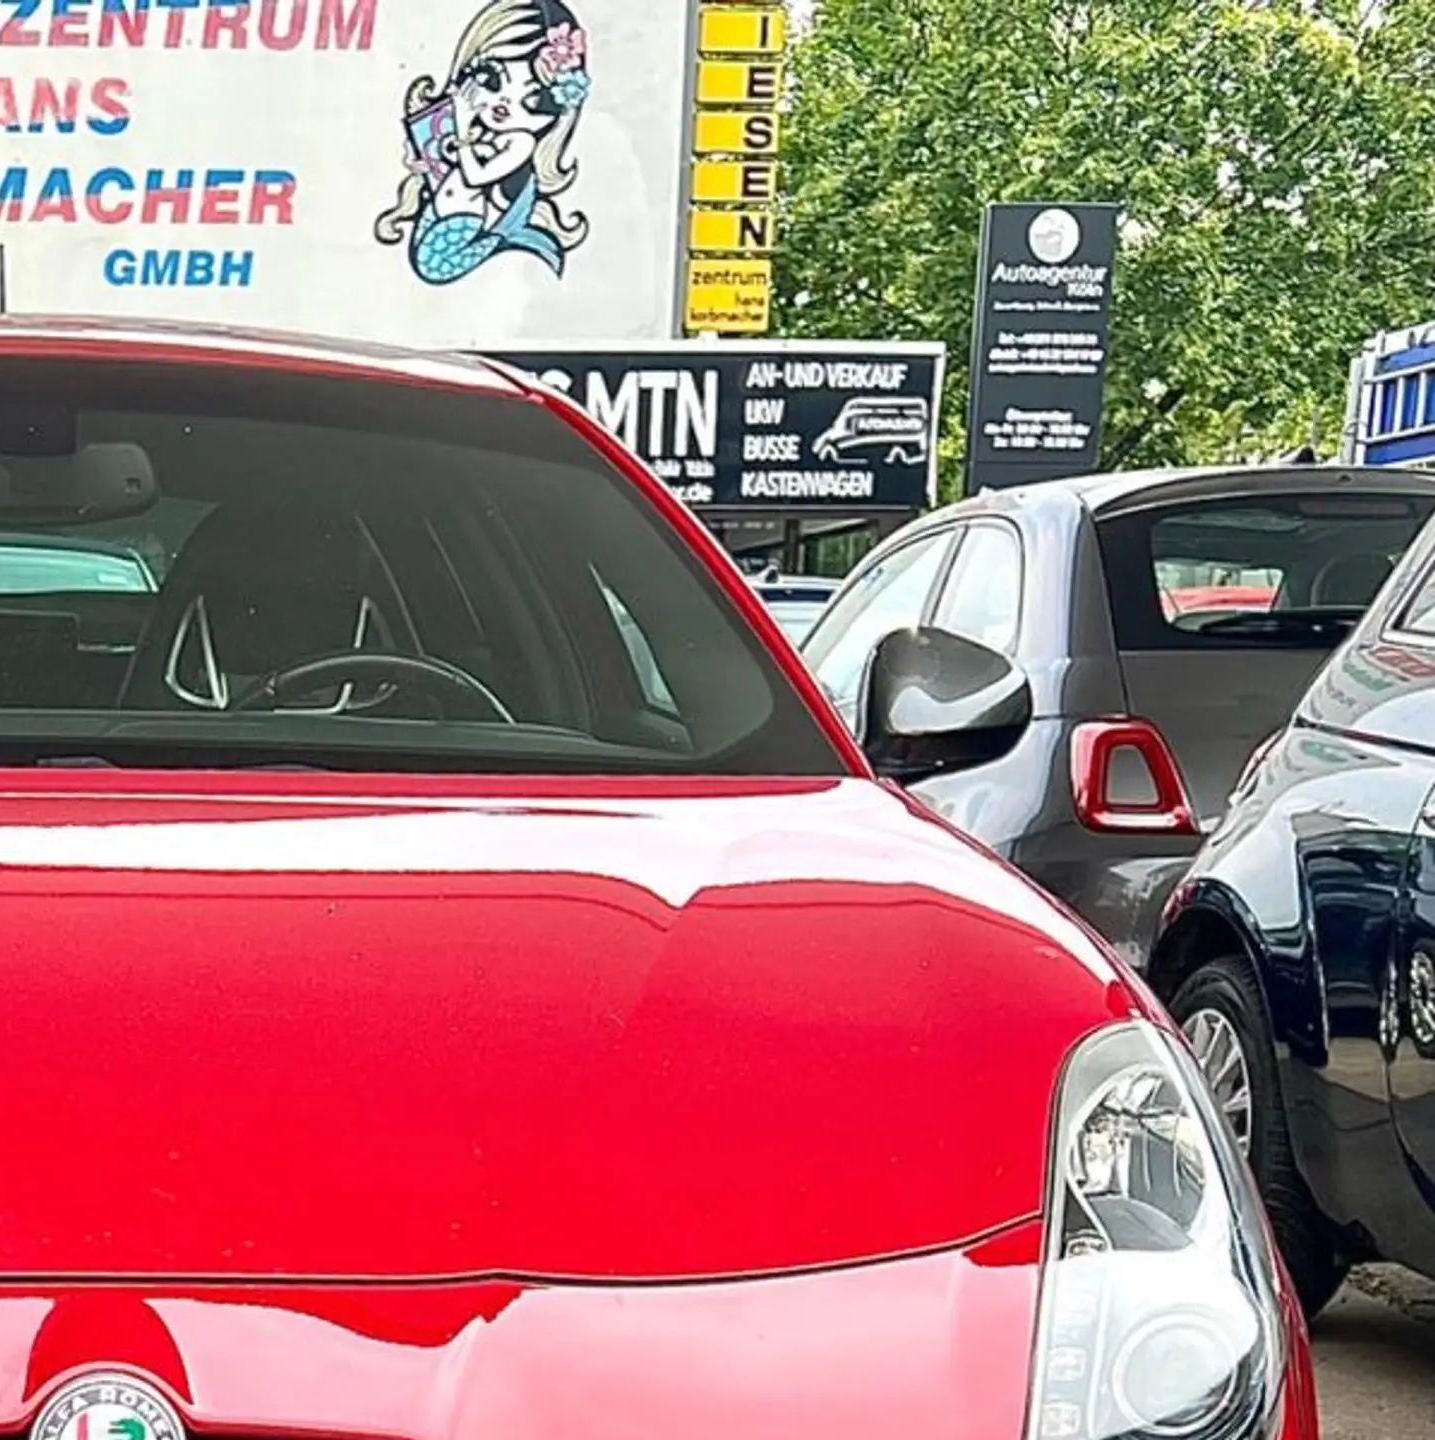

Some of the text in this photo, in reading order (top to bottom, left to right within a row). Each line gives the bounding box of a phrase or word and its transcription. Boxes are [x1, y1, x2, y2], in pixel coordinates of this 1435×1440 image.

[103, 249, 254, 288] GMBH
[991, 262, 1108, 287] Autoagentur
[825, 363, 908, 389] VERKAUF
[586, 370, 719, 457] MTN
[743, 434, 801, 461] BUSSE
[740, 471, 874, 497] KASTENWAGEN
